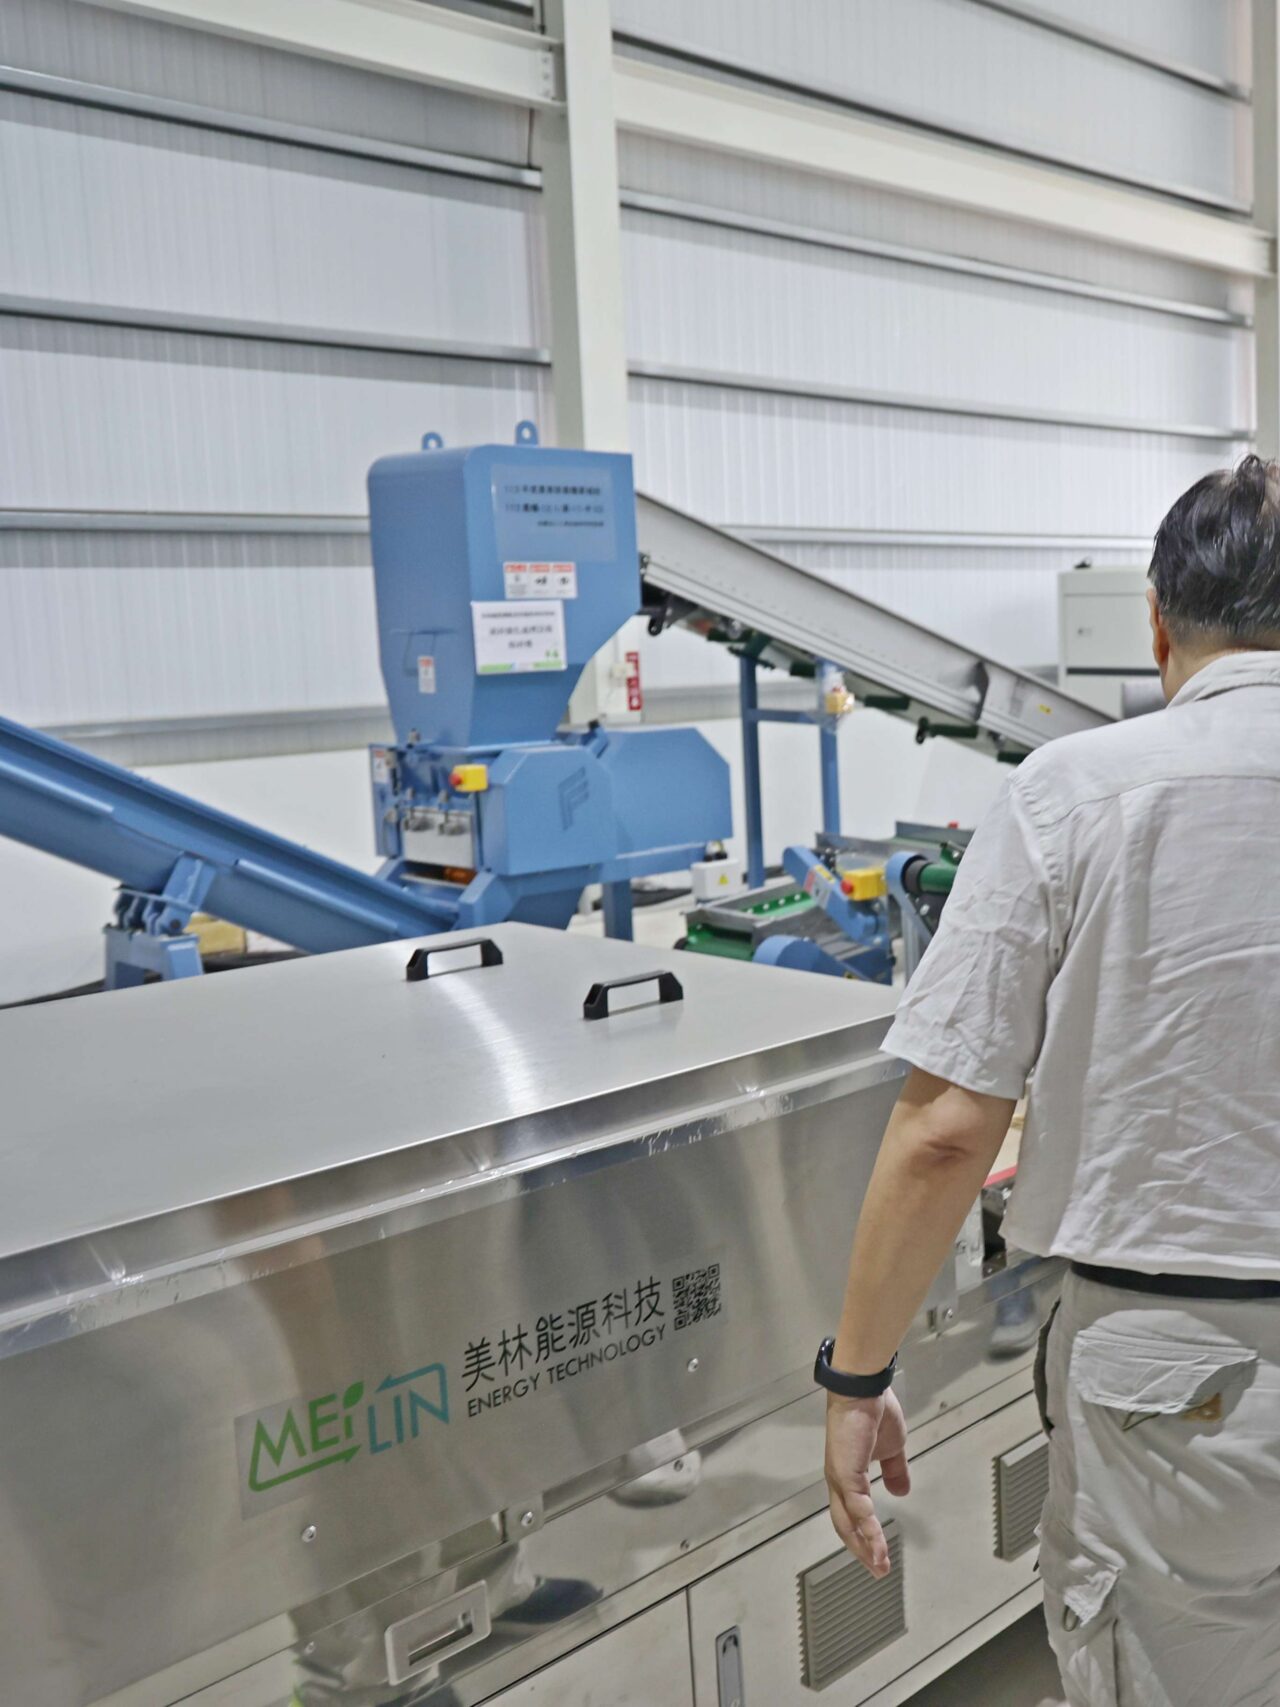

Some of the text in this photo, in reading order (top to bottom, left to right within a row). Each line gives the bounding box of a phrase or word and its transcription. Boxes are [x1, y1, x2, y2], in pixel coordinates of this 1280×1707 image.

[461, 1275, 665, 1393] 美林能源科技
[468, 1323, 667, 1418] ENERGY TECHNOLOGY
